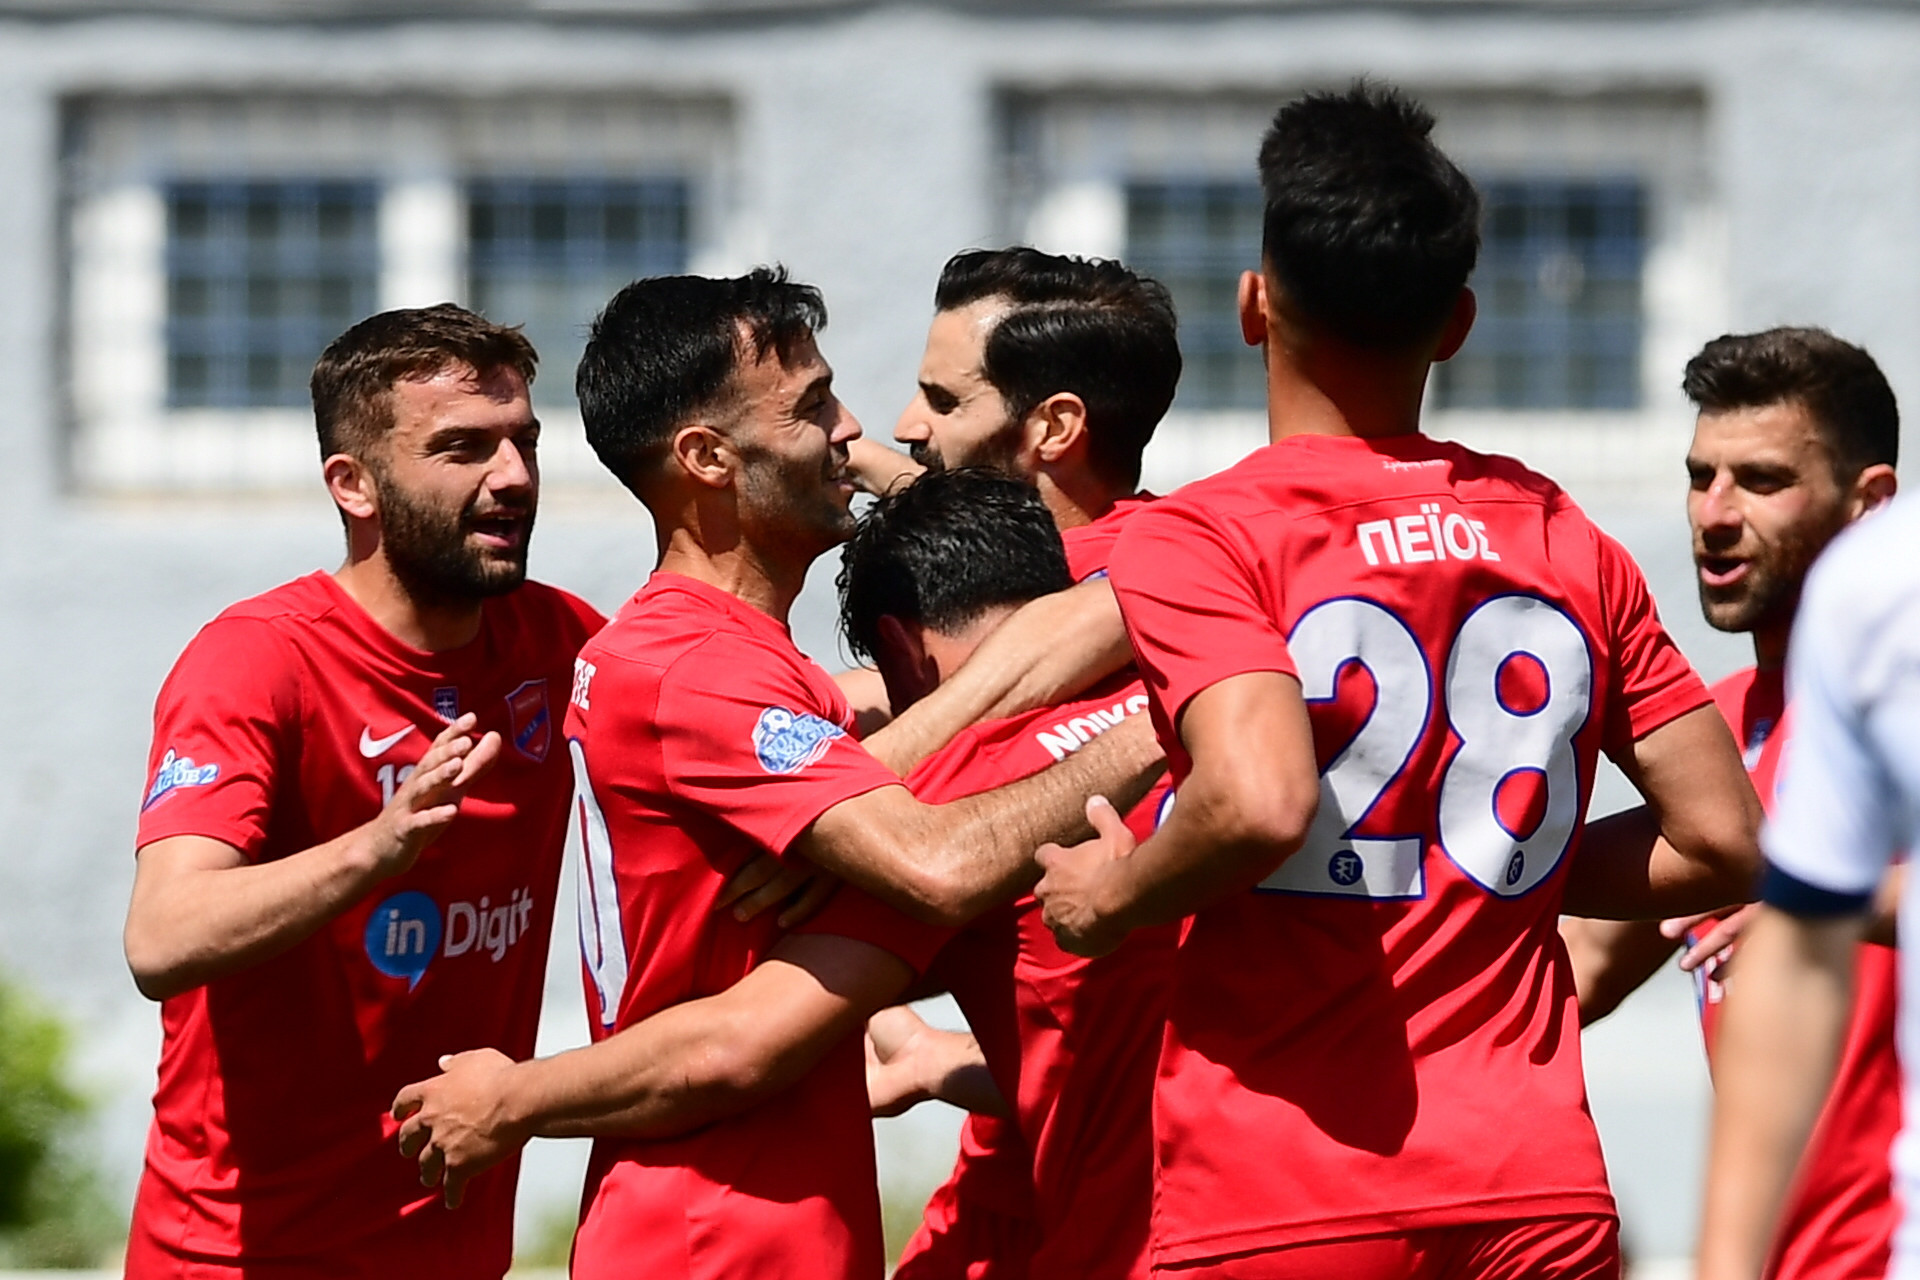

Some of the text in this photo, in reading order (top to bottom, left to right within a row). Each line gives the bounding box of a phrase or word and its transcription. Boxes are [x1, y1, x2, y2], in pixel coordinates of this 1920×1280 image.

[1357, 503, 1501, 566] ΠΕΪΟΣ
[1253, 593, 1595, 900] 28
[385, 886, 533, 963] in Digit
